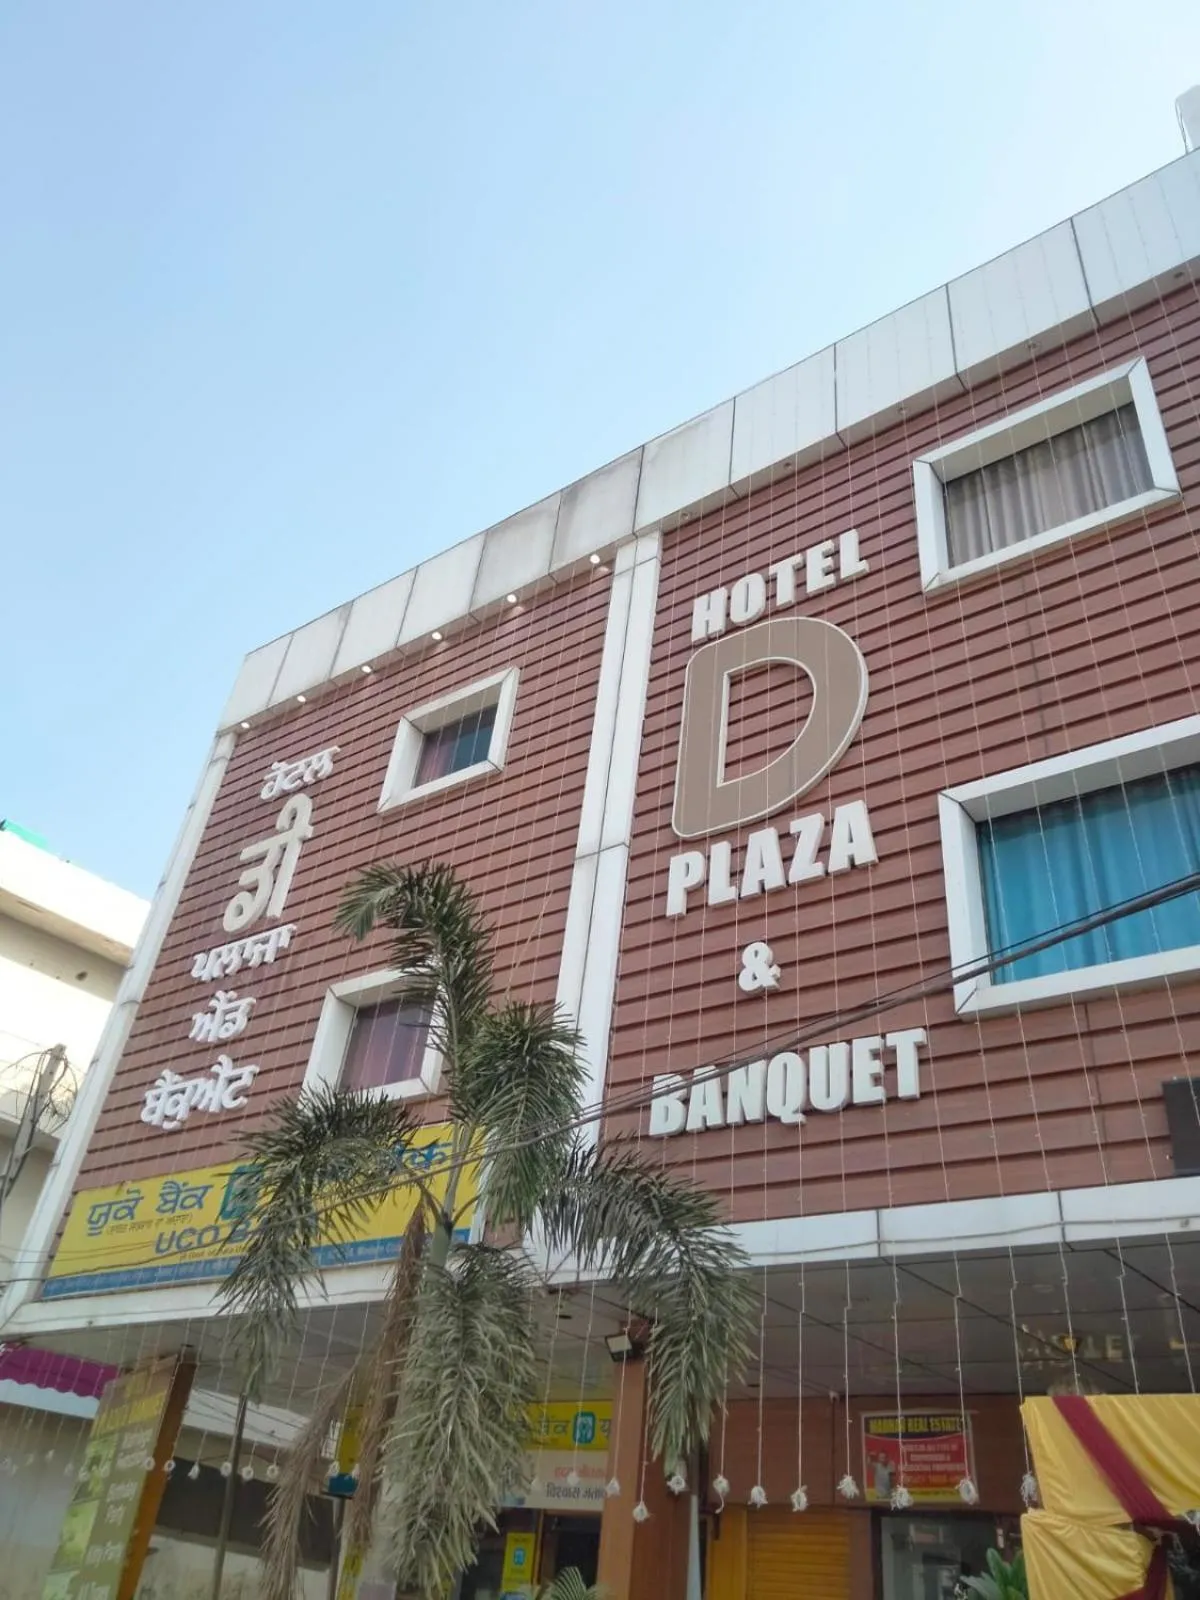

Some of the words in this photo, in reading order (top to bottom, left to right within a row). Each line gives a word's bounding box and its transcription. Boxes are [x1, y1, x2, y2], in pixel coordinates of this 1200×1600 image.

[691, 529, 870, 643] HOTEL
[672, 616, 869, 838] D
[223, 793, 314, 932] ਡੀ
[666, 800, 879, 918] PLAZA
[738, 941, 781, 995] &
[649, 1027, 928, 1138] BANQUET
[86, 1187, 145, 1237] ਯੂਕੋ
[155, 1180, 214, 1215] ਬੈਂਕ
[154, 1224, 220, 1255] UCO
